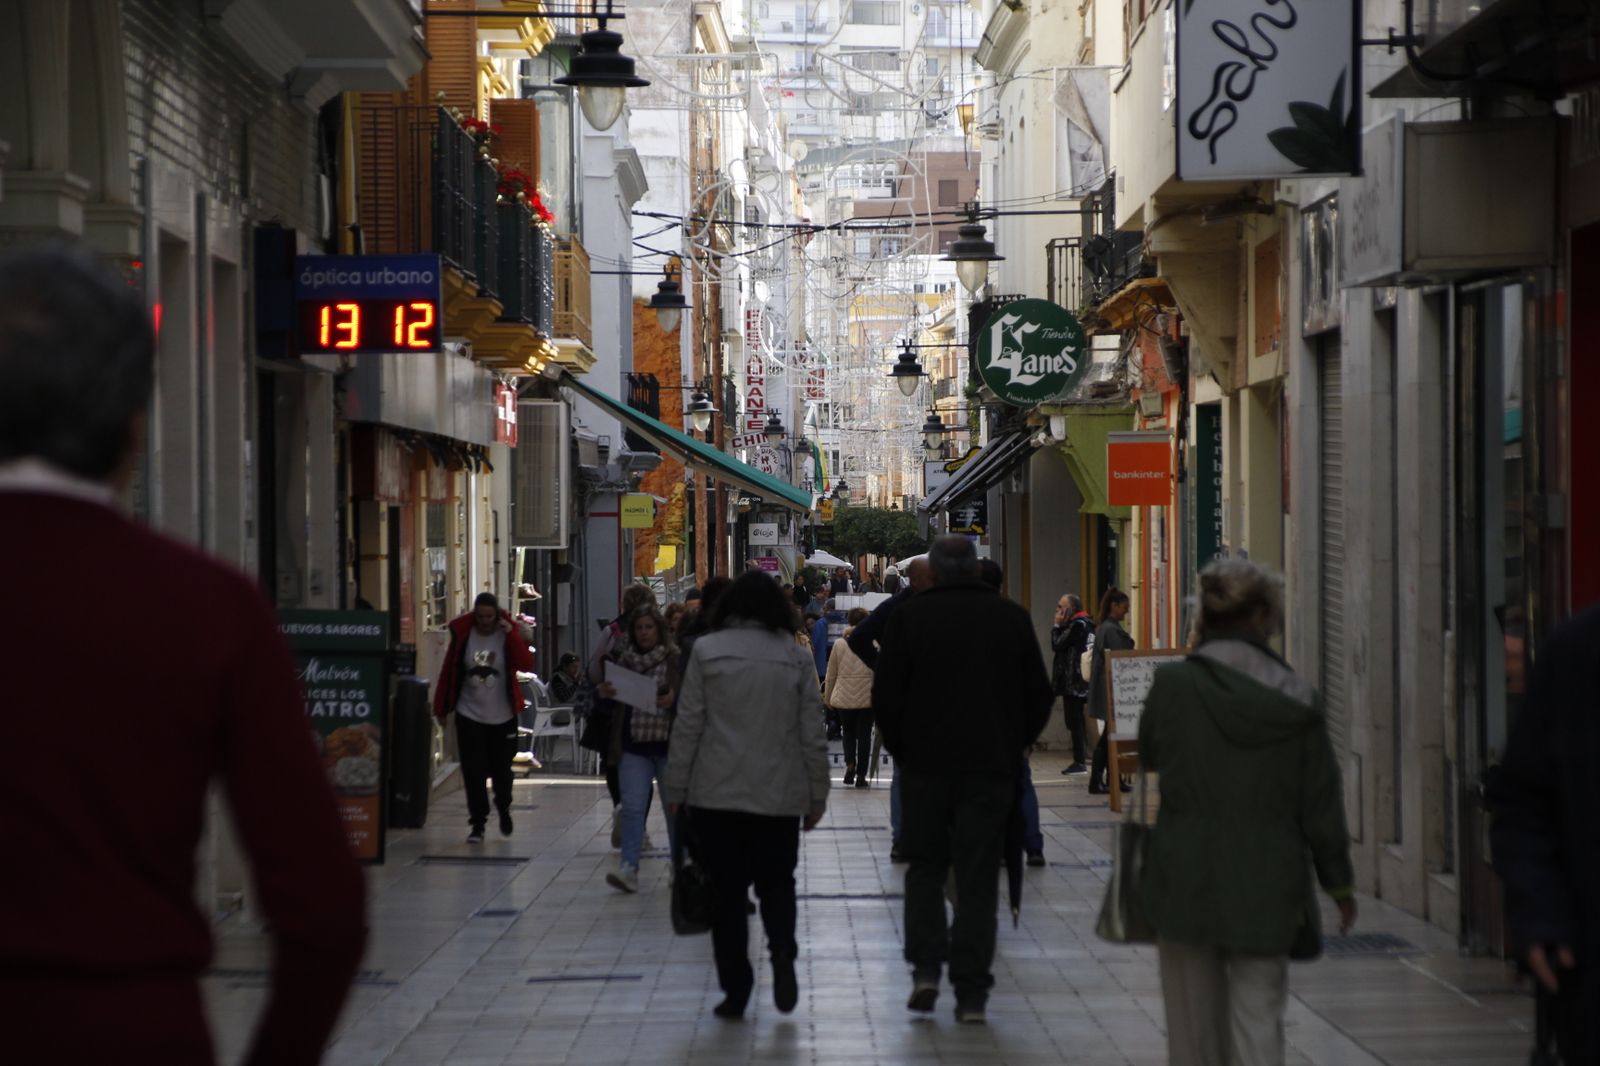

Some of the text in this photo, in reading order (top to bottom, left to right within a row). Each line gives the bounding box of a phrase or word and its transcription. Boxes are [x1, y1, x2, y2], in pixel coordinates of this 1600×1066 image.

[300, 266, 435, 288] óptica urbano
[318, 301, 434, 350] 13 12
[1041, 326, 1076, 339] Tiendas
[325, 624, 382, 636] SABORES
[296, 657, 361, 684] Malvón
[340, 688, 366, 699] LOS
